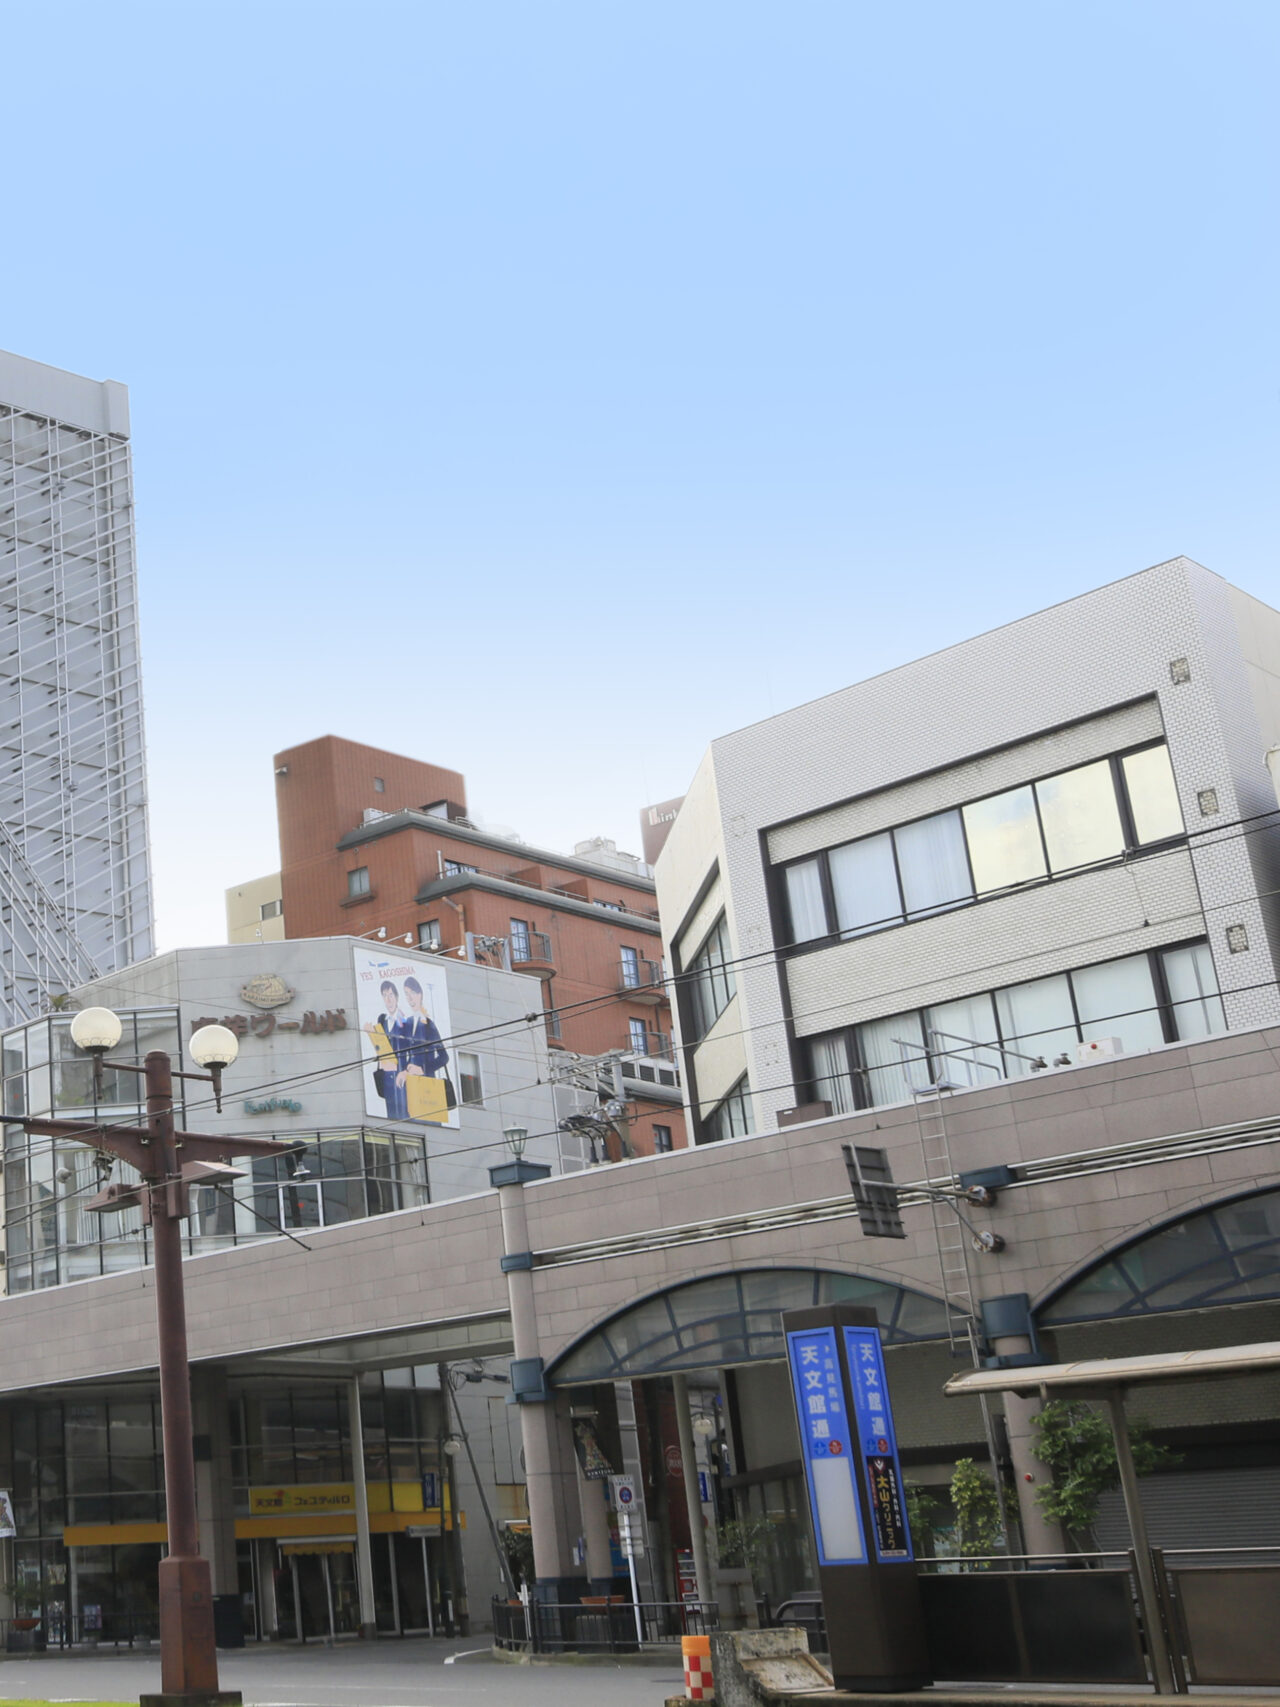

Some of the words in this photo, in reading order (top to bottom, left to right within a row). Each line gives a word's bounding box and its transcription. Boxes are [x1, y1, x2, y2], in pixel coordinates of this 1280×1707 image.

[360, 971, 373, 981] YES
[379, 966, 416, 979] KAGOSHIMA
[800, 1345, 831, 1439] 天文館通
[859, 1343, 886, 1436] 天文館通
[877, 1475, 896, 1549] 大山クリニック
